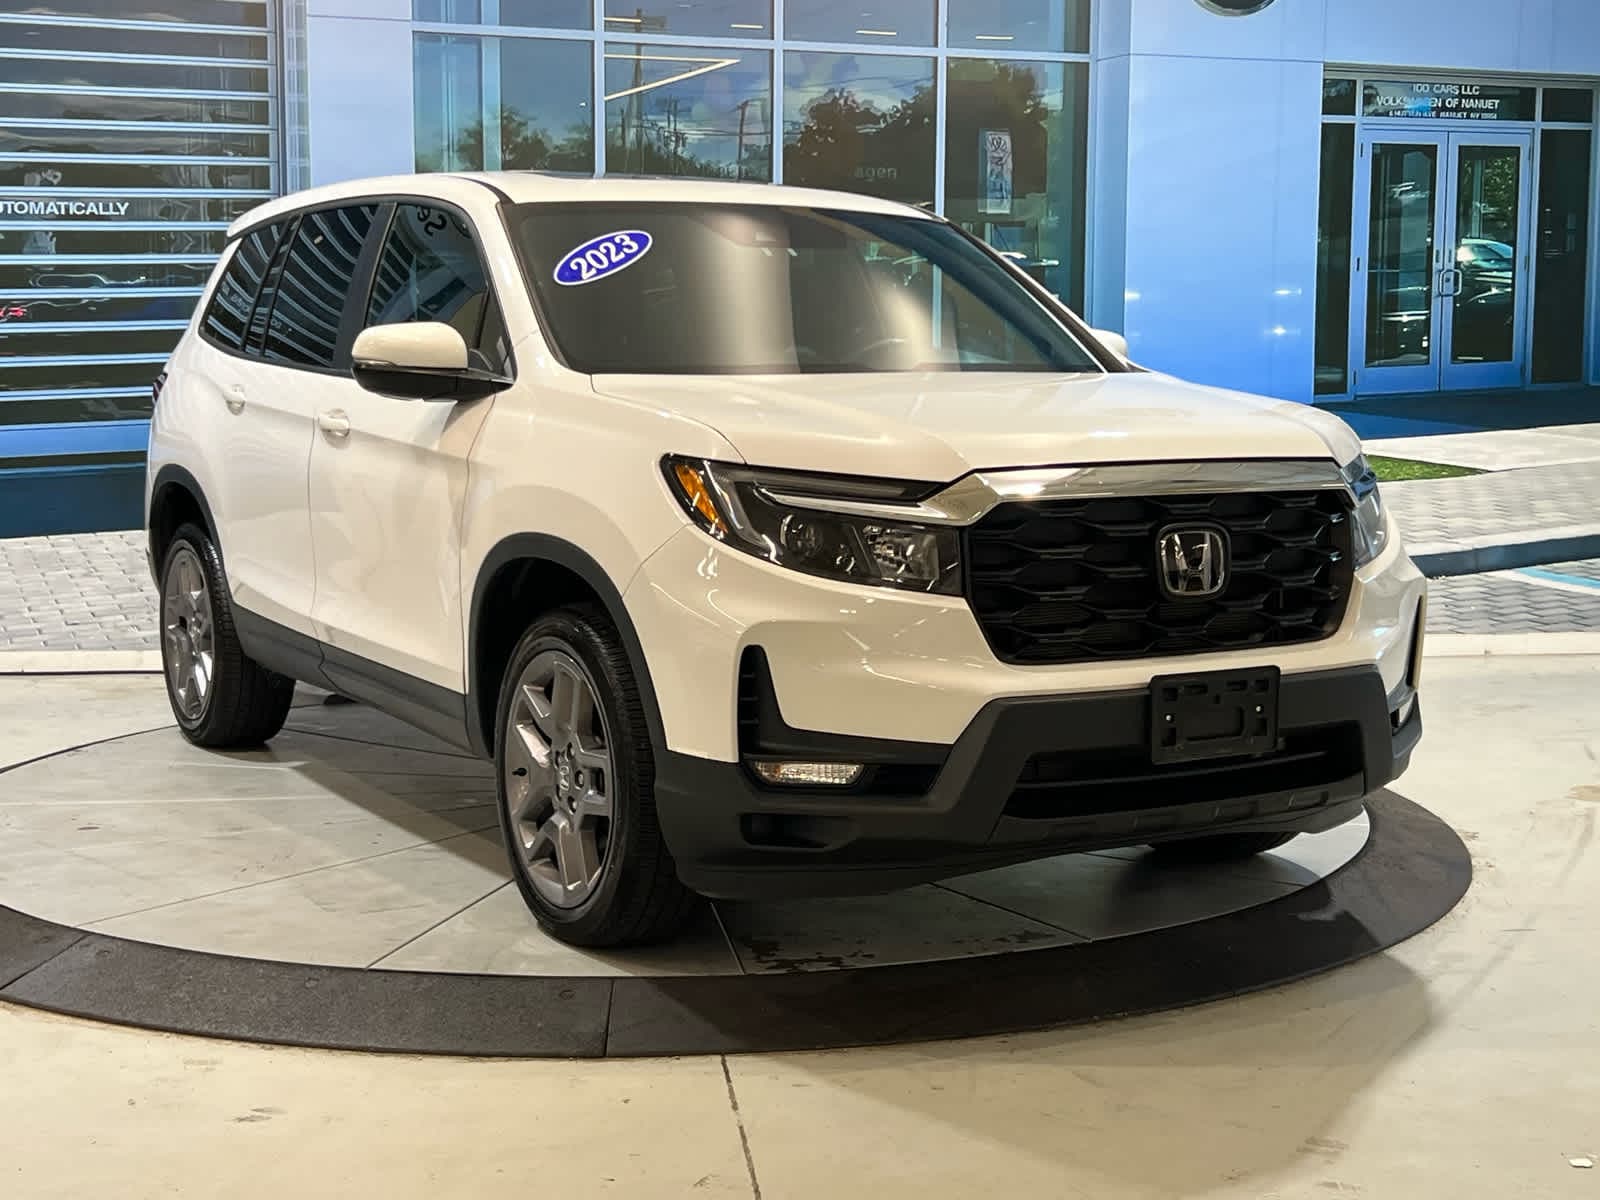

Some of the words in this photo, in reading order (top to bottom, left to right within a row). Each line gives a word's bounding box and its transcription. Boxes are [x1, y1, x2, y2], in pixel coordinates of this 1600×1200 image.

[1432, 84, 1460, 95] CARS
[1461, 85, 1480, 95] LLC
[1445, 97, 1460, 108] OF
[1461, 98, 1501, 110] NANUET
[569, 233, 639, 280] 2023
